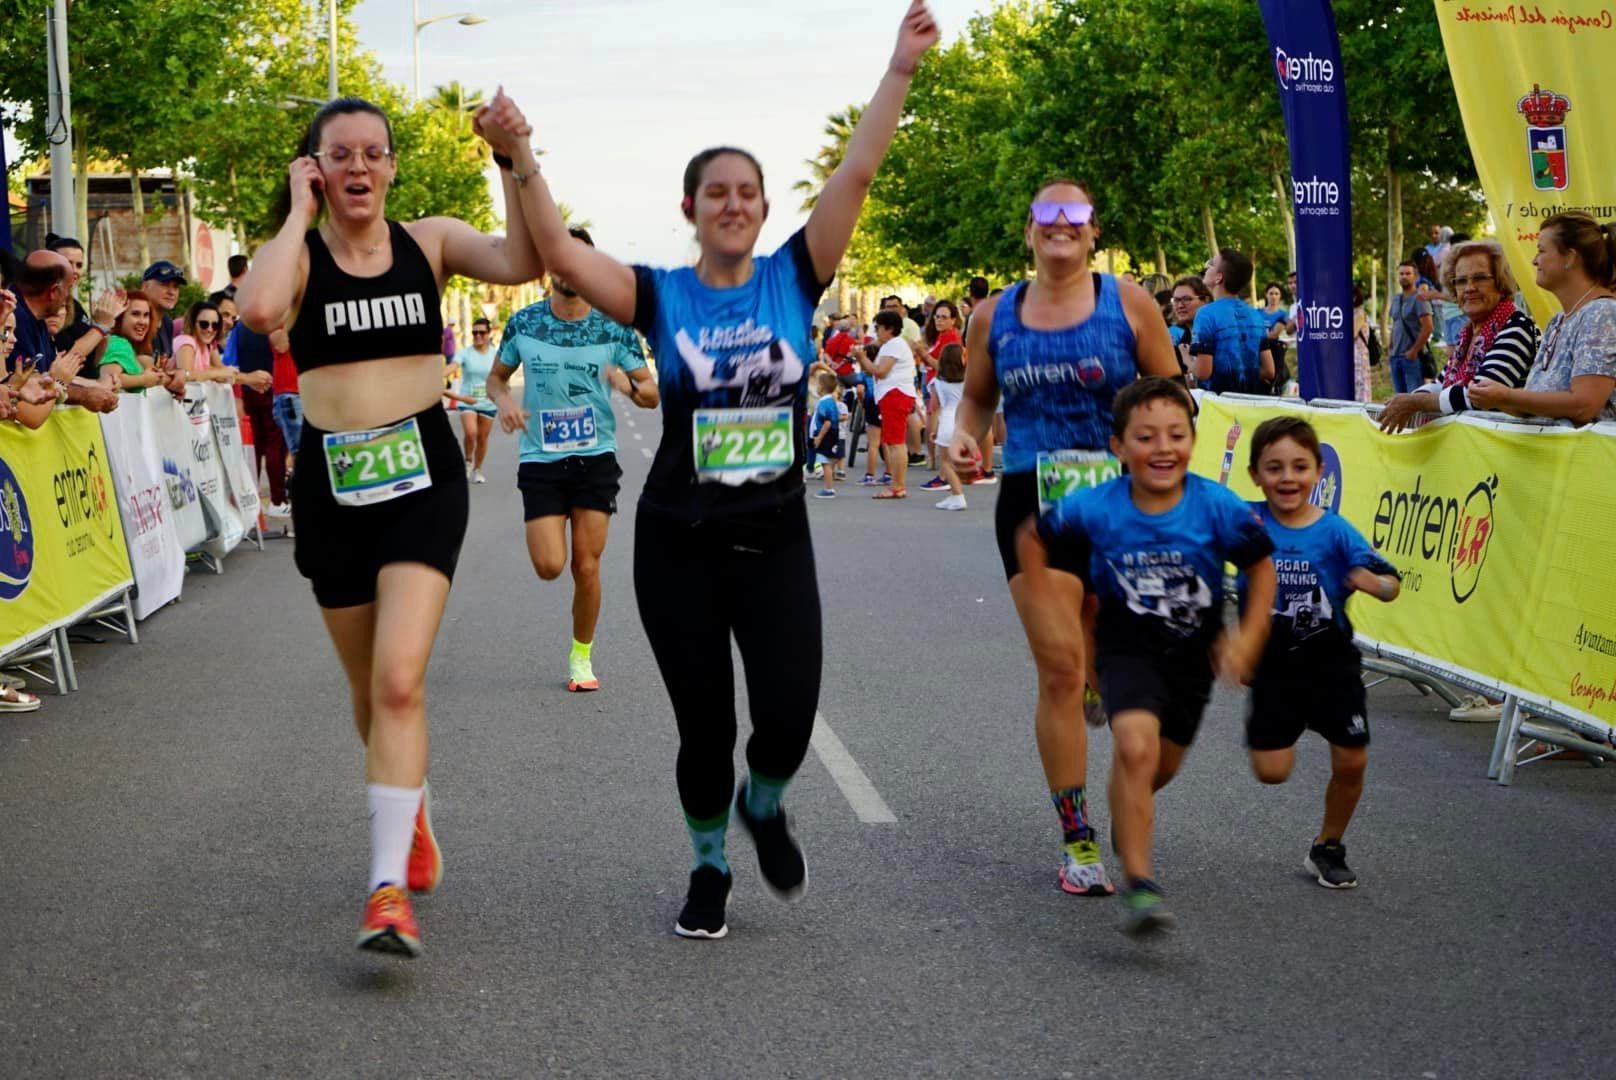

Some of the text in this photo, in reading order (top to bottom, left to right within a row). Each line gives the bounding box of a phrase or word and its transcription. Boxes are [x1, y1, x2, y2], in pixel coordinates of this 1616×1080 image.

[324, 292, 427, 336] PUMA
[557, 416, 595, 440] 315
[354, 439, 421, 482] 218
[725, 428, 789, 466] 222
[1137, 550, 1183, 567] ROAD
[1275, 559, 1310, 572] ROAD
